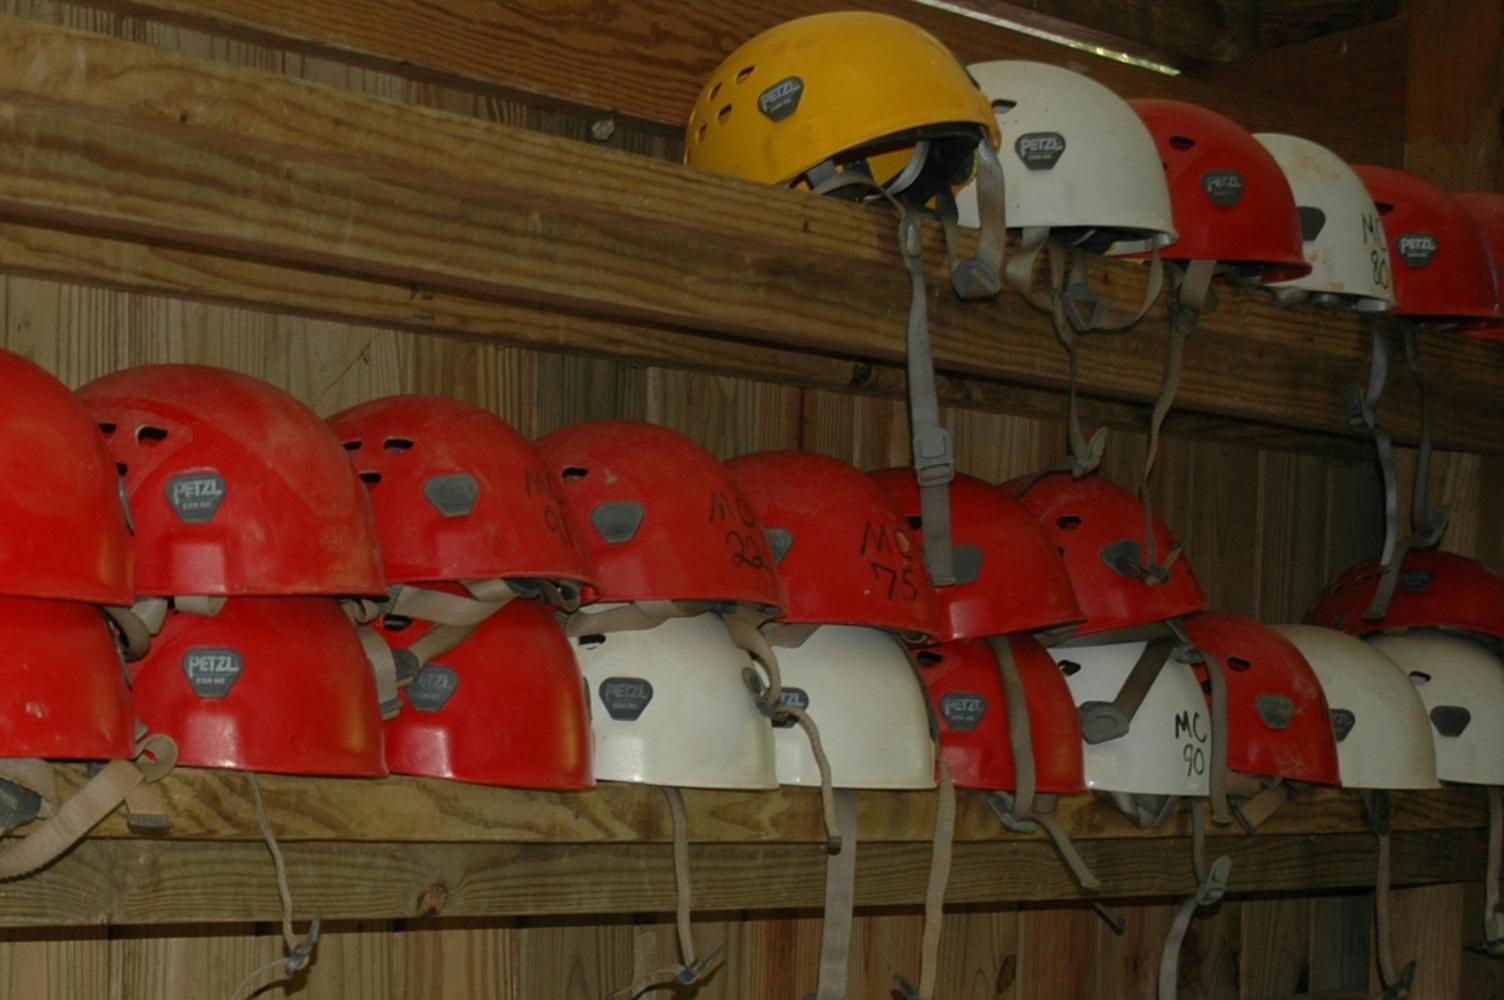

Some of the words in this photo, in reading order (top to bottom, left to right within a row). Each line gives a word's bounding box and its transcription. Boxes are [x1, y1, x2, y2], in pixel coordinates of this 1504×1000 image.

[761, 80, 800, 111] PETZL
[1022, 138, 1063, 157] PETZL
[1400, 239, 1436, 255] PETZL
[174, 478, 222, 505] PETZL
[871, 562, 918, 602] 75
[189, 656, 240, 678] PETZL
[606, 684, 648, 704] PETZL
[1175, 711, 1207, 743] MC
[1183, 743, 1204, 777] 90
